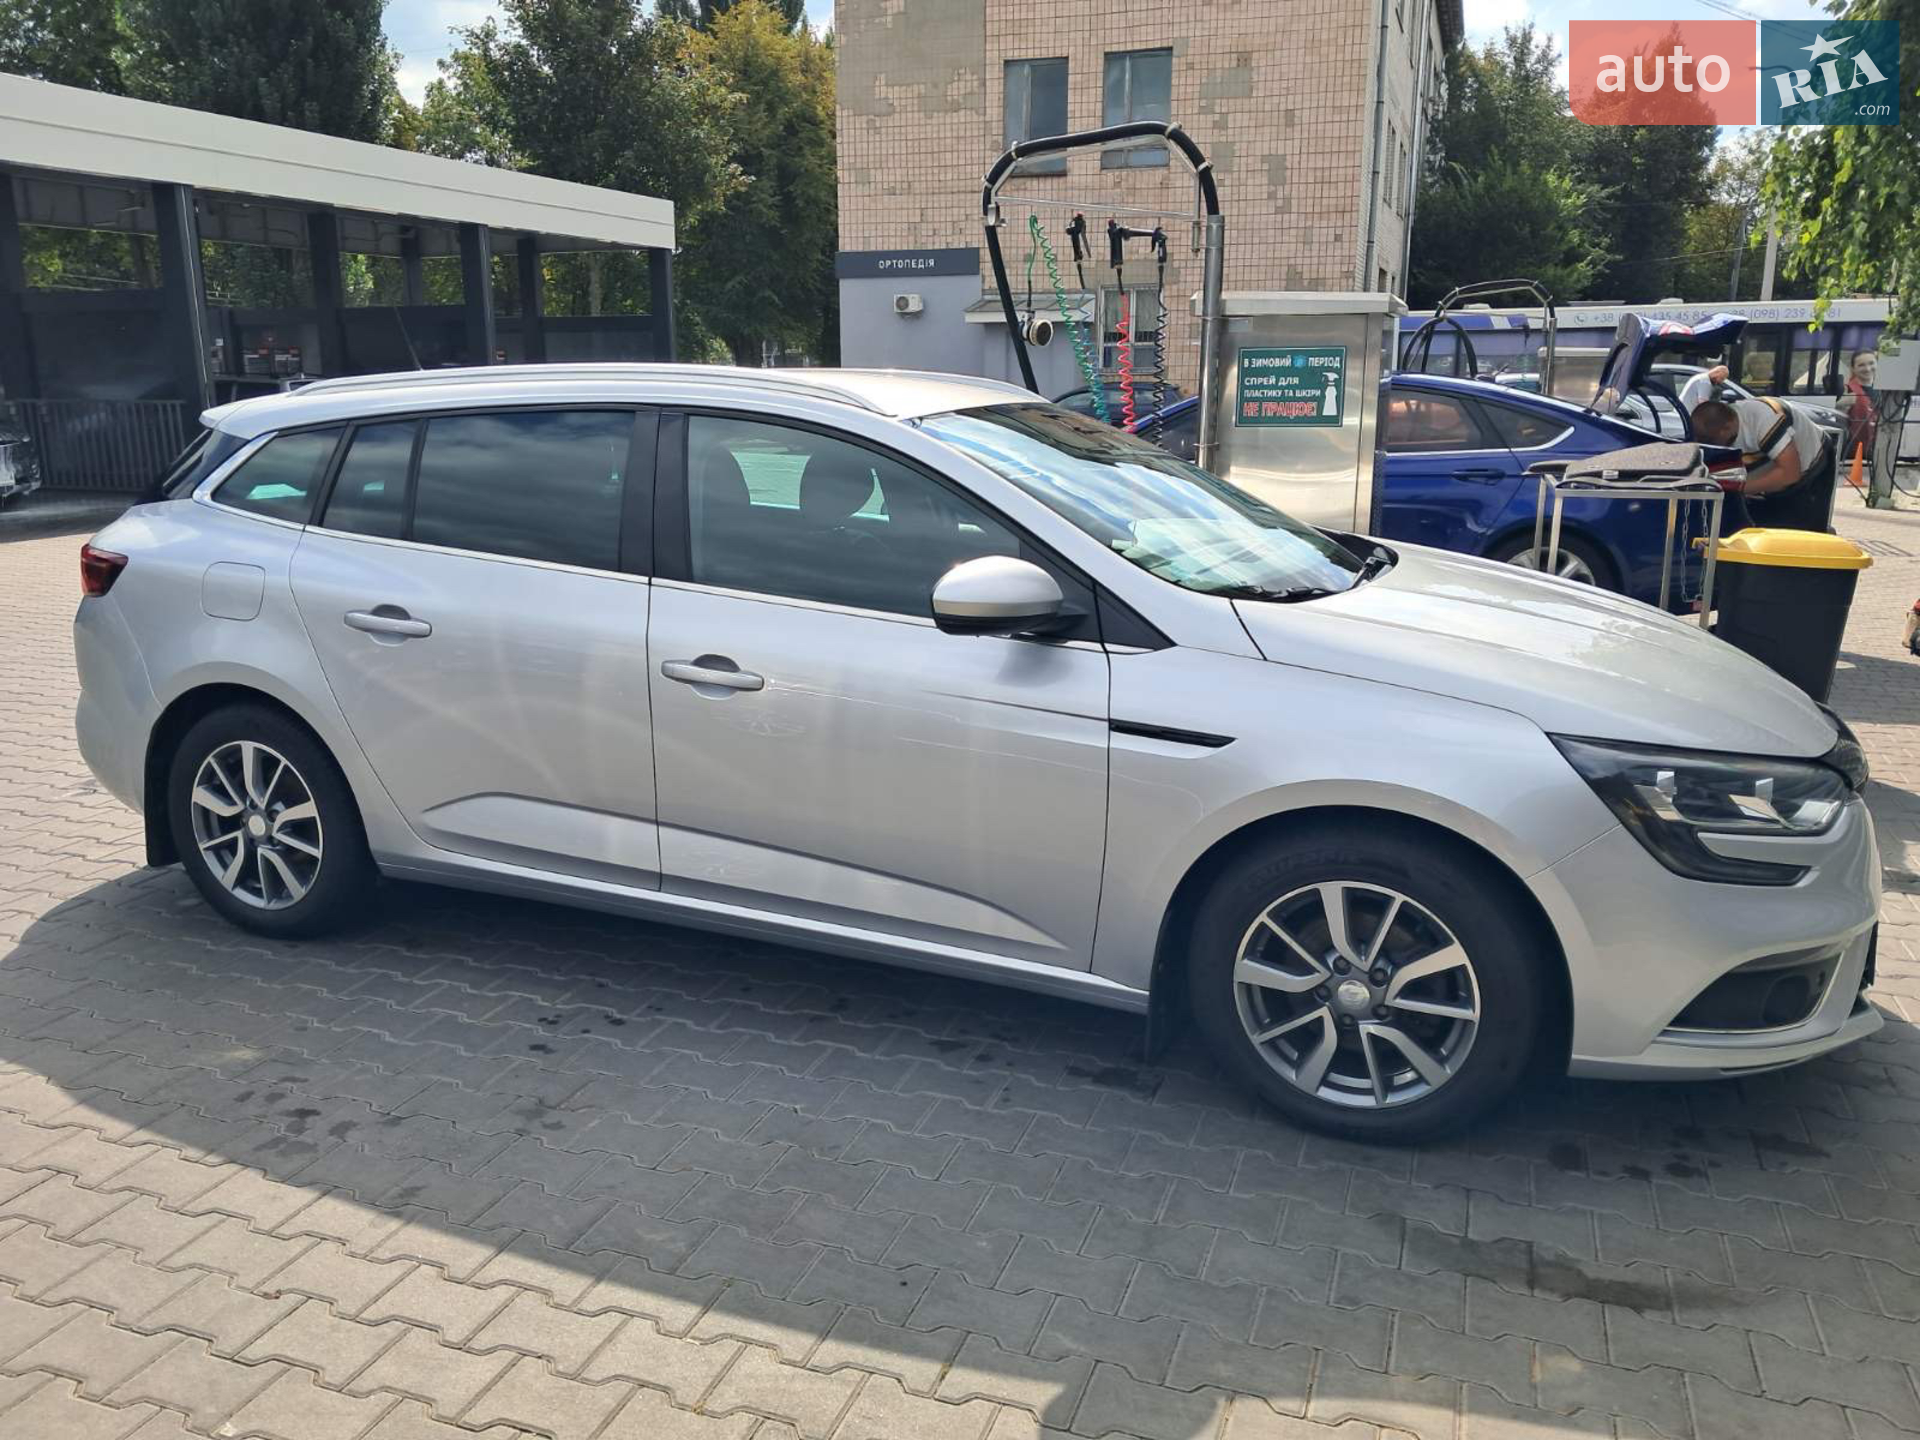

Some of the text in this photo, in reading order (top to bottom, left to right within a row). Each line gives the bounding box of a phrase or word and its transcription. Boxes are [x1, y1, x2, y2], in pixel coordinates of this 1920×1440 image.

[878, 258, 935, 269] ОРТОПЕДІЯ
[1593, 312, 1614, 323] +38
[1750, 307, 1780, 321] (098)
[1784, 307, 1806, 319] 239
[1243, 355, 1341, 369] В ЗИМОВИЙ ПЕРІОД
[1244, 375, 1300, 386] СПРЕЙ ДЛЯ
[1243, 389, 1321, 398] ПЛАСТИКУ ТА ШКІРИ
[1242, 401, 1318, 419] НЕ ПРАЦЮЄ!
